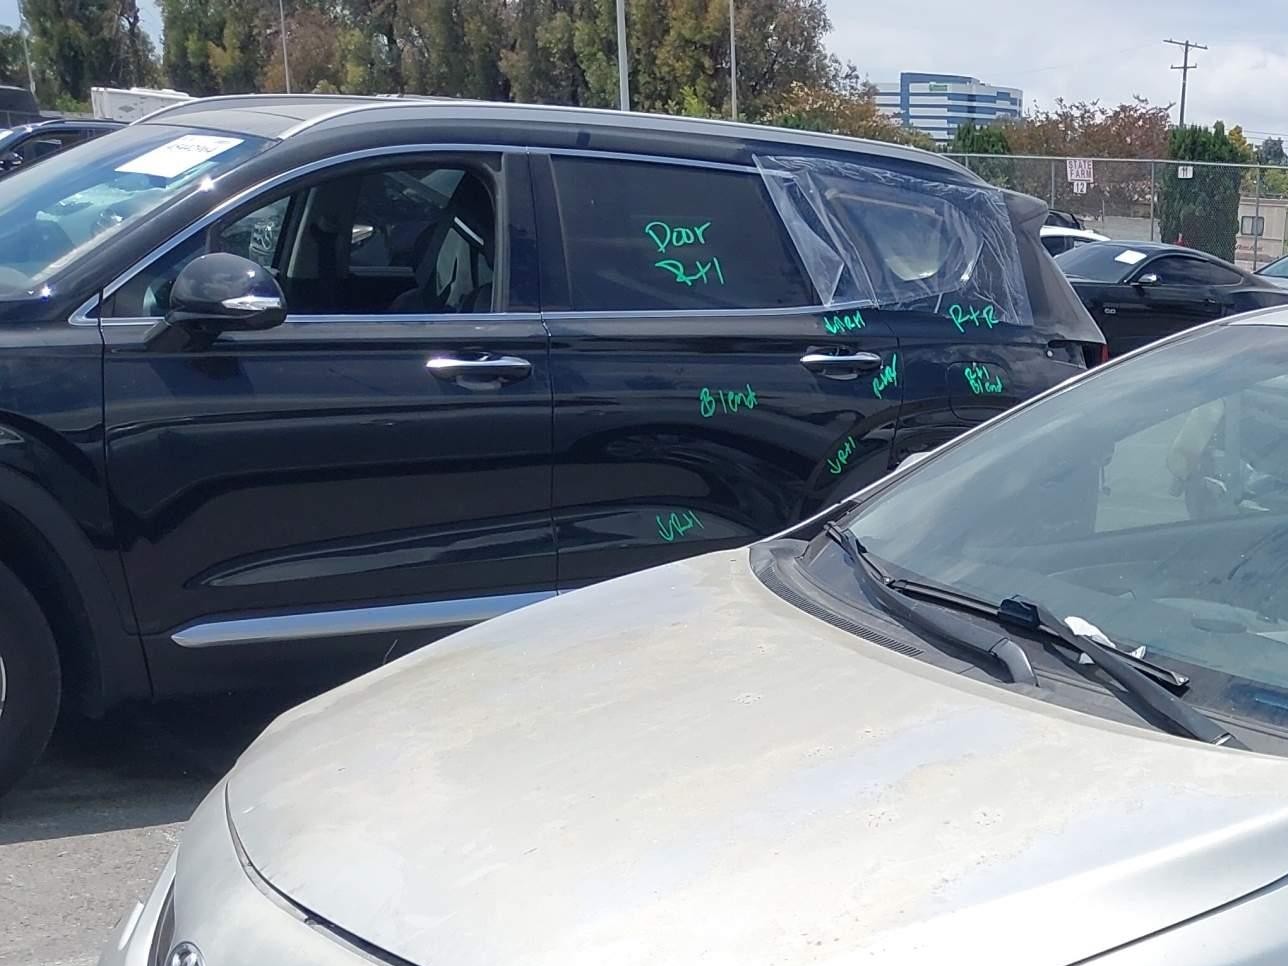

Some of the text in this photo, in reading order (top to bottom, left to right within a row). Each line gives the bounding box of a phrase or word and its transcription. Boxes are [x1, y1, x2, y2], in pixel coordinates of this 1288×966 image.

[1068, 160, 1092, 169] STATE
[1070, 169, 1091, 178] FARM
[1075, 182, 1085, 192] 12
[645, 221, 711, 253] Door
[700, 383, 758, 417] Blend
